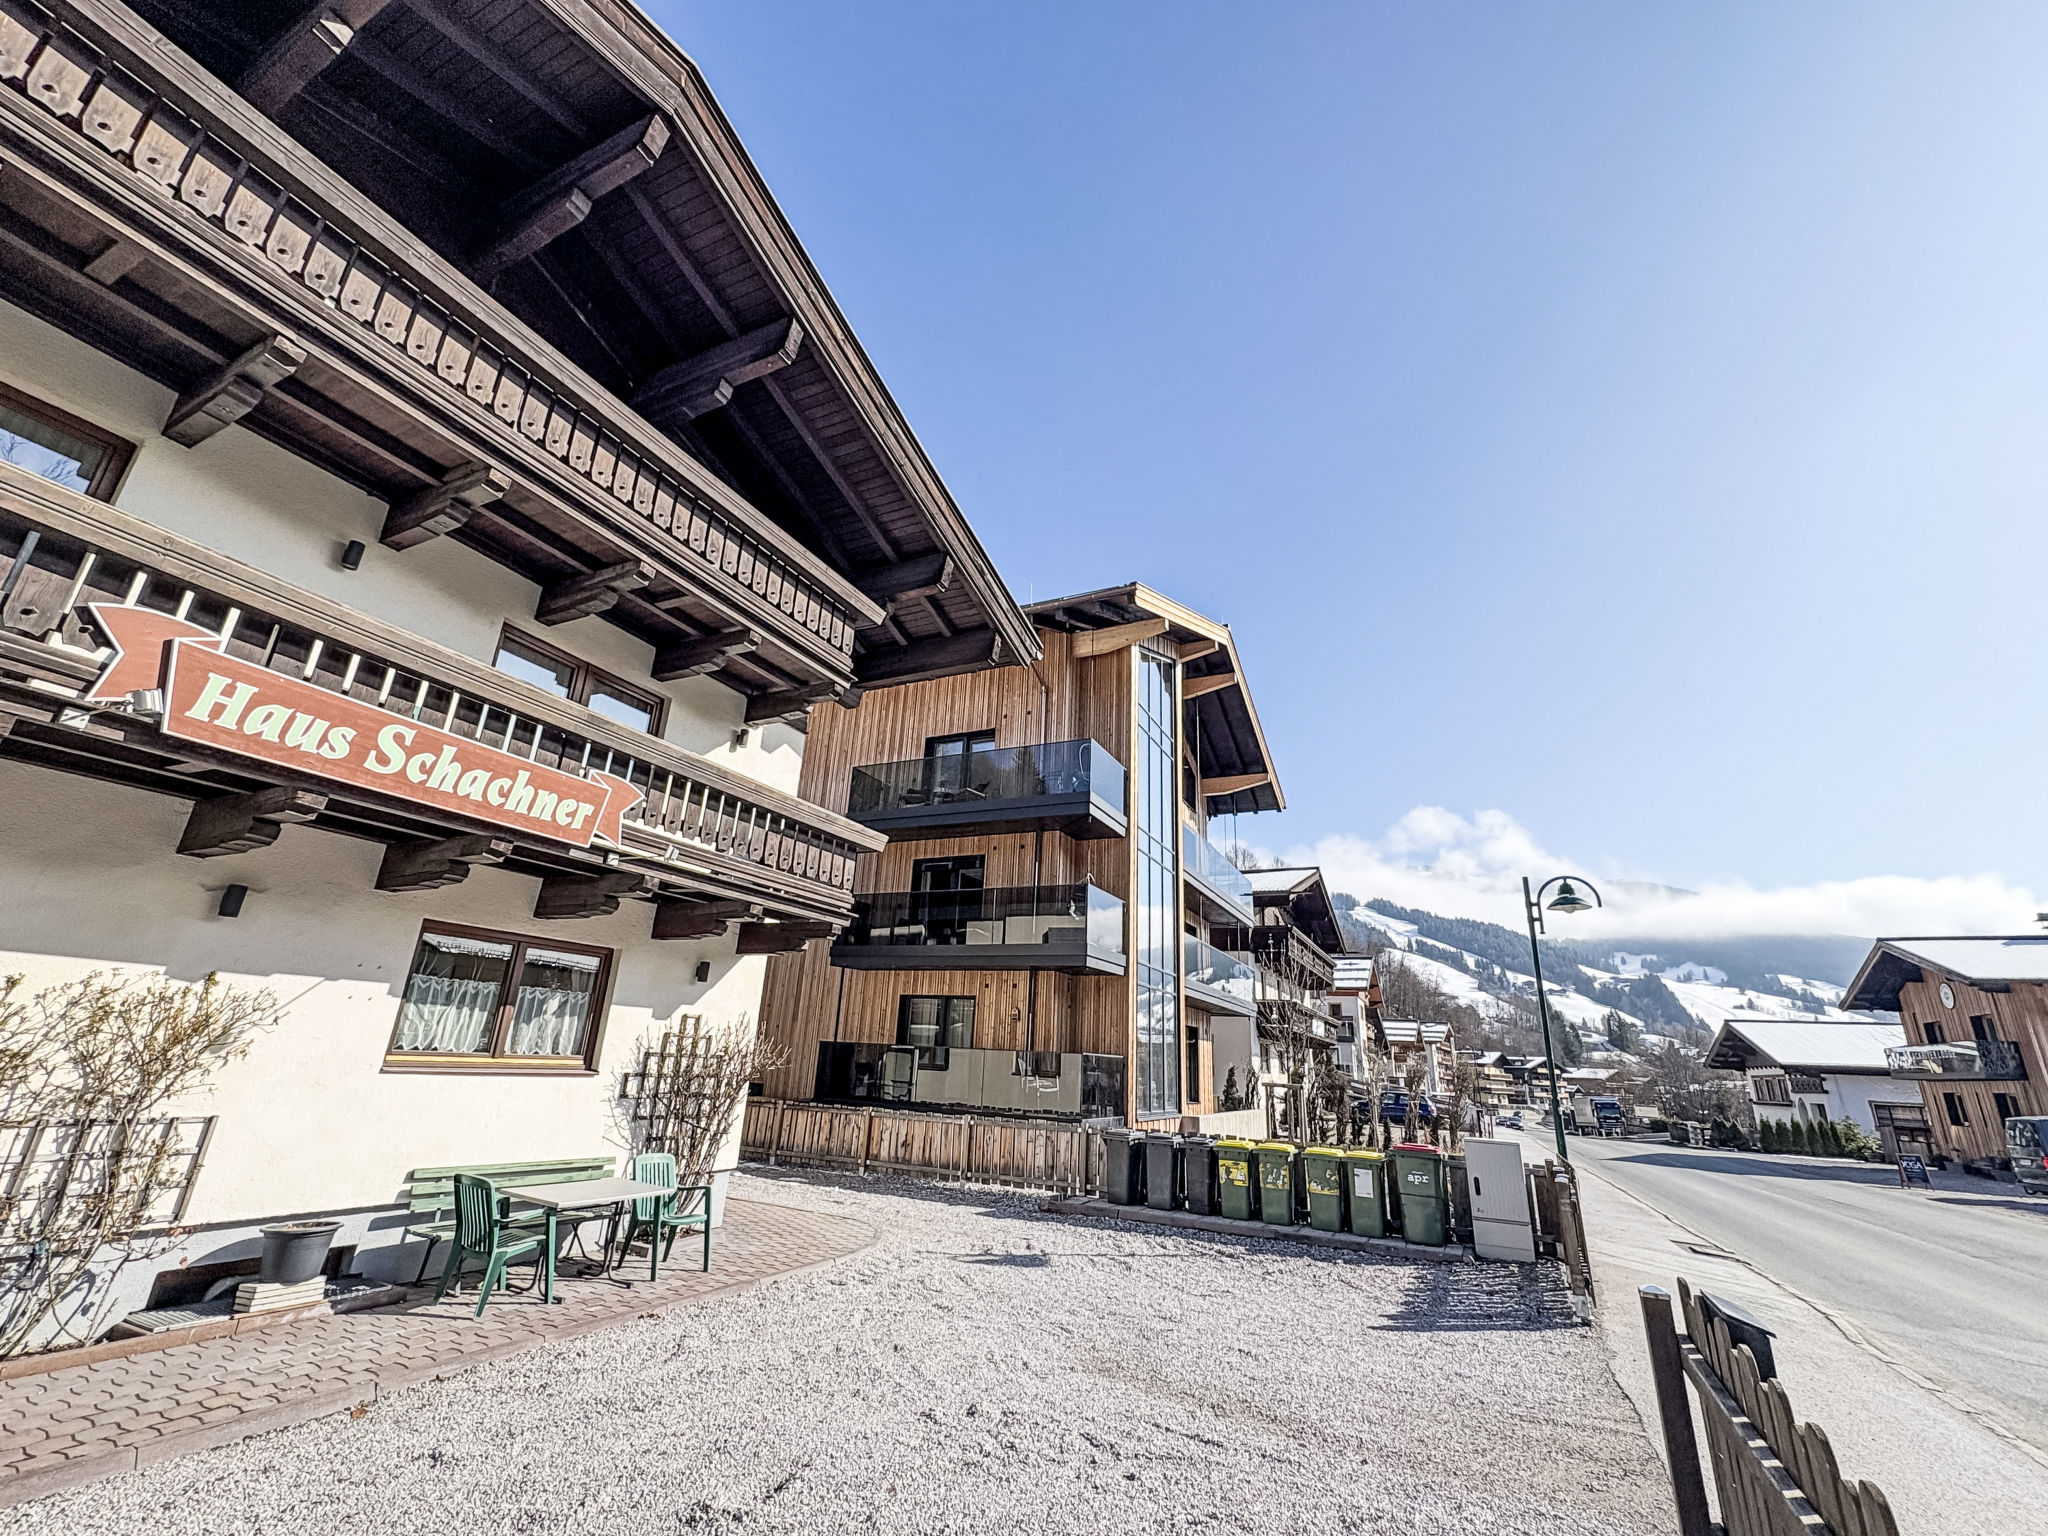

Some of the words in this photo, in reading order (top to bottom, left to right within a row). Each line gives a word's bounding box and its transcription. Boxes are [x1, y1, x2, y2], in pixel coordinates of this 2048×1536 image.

[184, 672, 357, 760] Haus
[363, 723, 595, 830] Schachner
[1900, 1160, 1924, 1170] YOGA
[1407, 1174, 1430, 1185] apr
